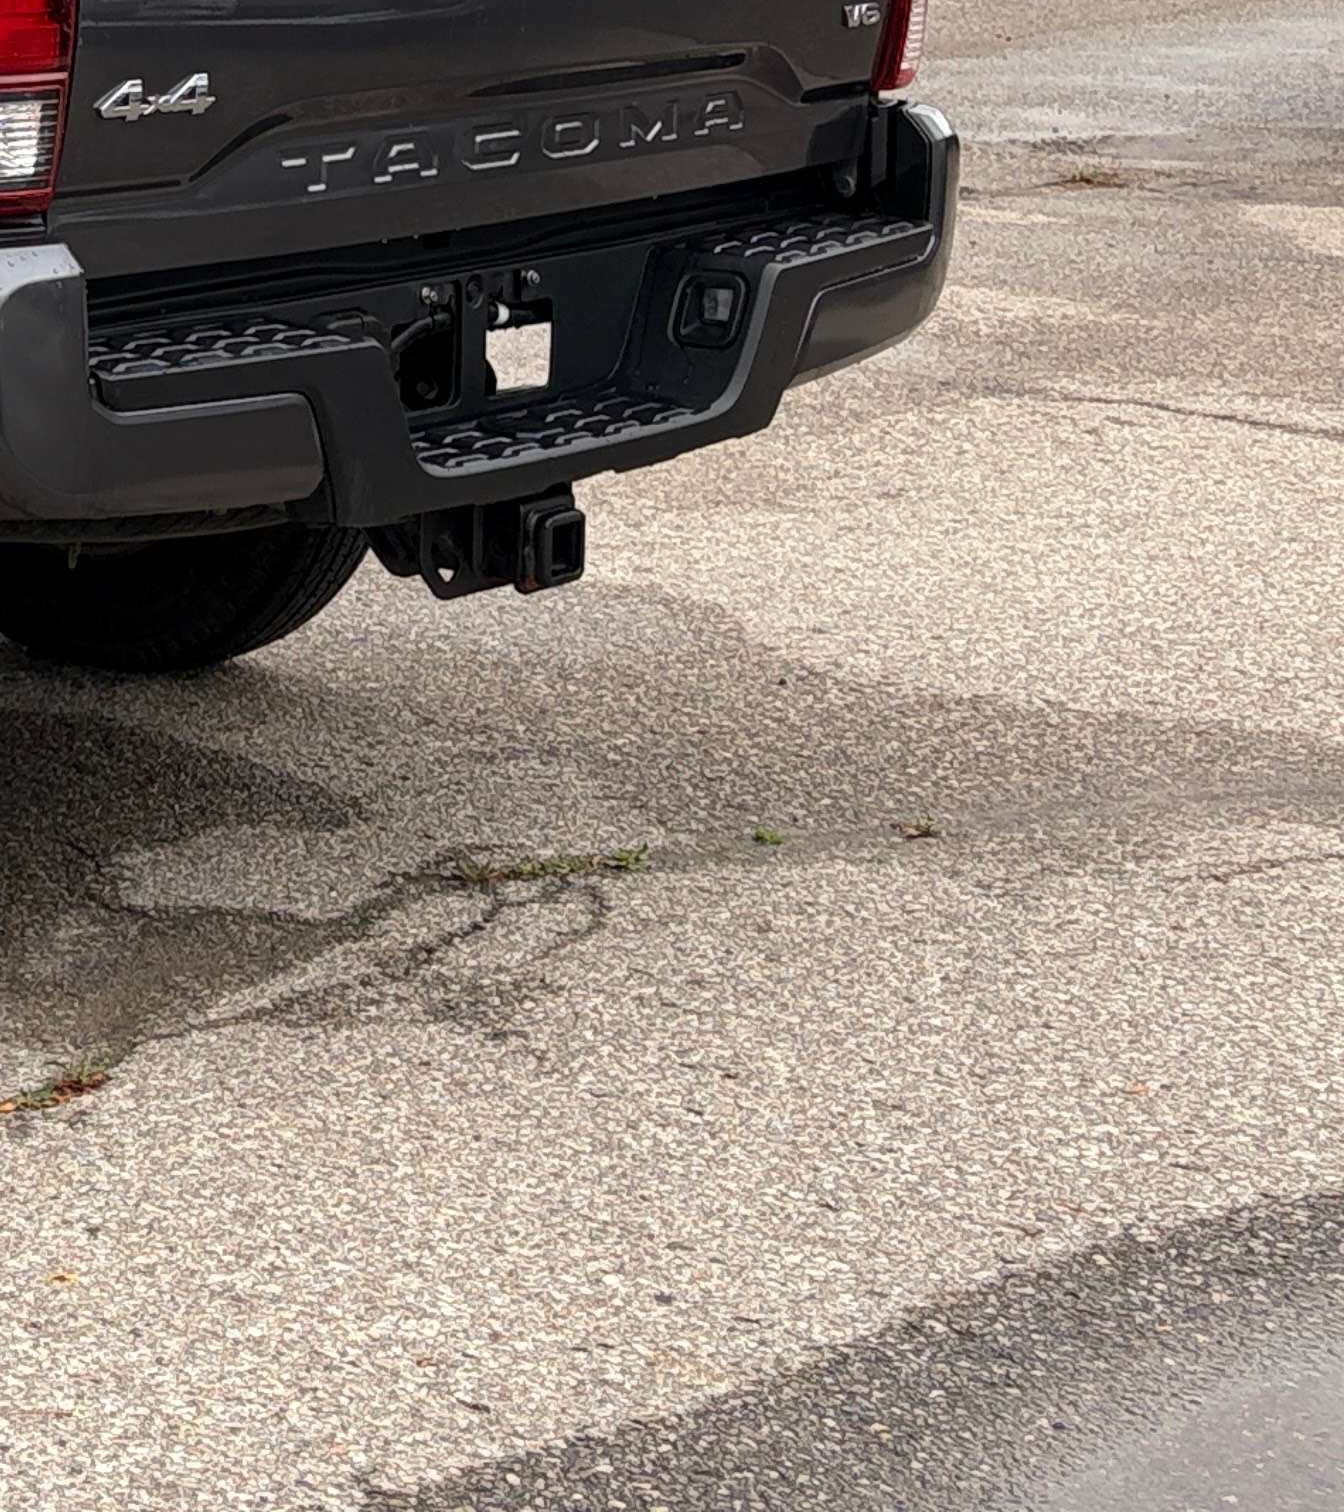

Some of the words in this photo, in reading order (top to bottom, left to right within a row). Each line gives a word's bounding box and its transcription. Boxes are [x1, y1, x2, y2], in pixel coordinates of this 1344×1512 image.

[843, 1, 881, 28] V6
[93, 72, 216, 122] 4x4
[279, 89, 746, 194] TACOMA
